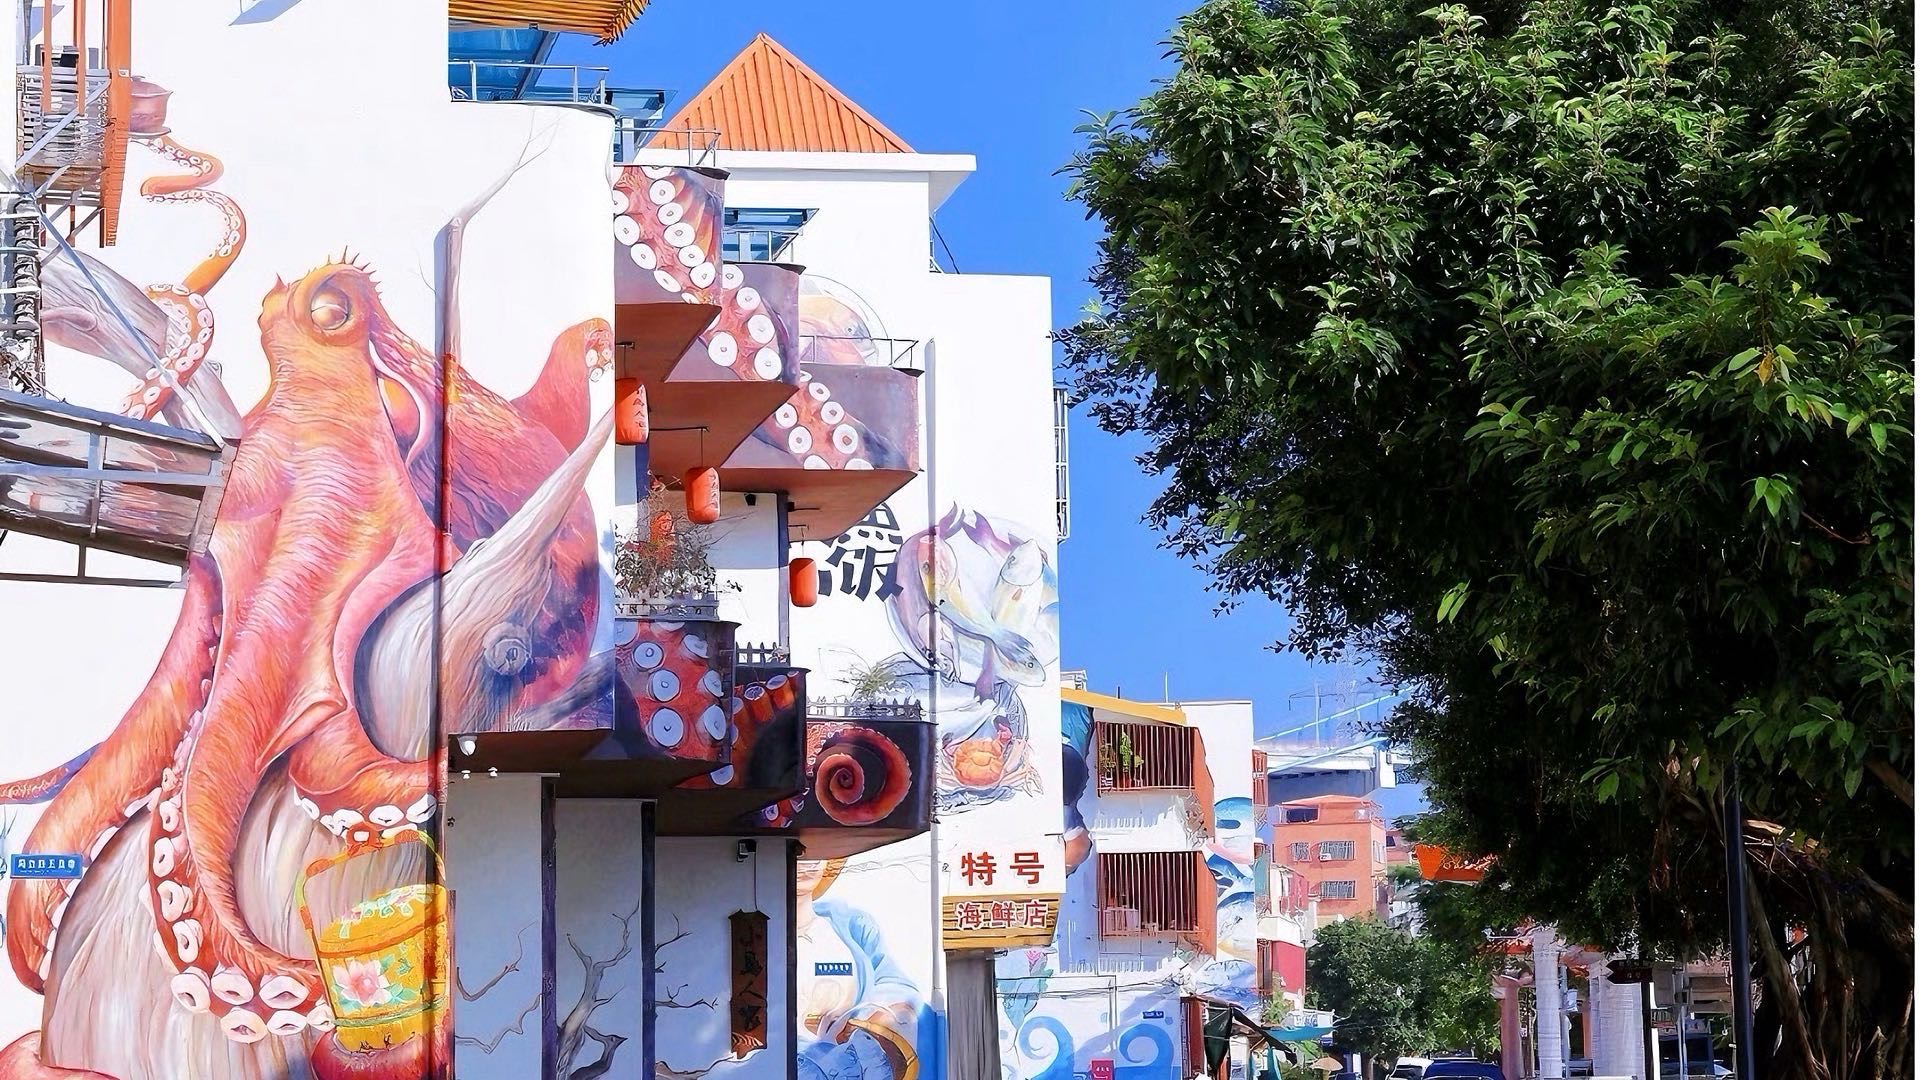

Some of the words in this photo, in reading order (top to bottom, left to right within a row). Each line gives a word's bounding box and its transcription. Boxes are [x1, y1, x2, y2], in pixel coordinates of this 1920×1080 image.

[960, 852, 1044, 886] 特号
[957, 901, 1047, 928] 海鲜店
